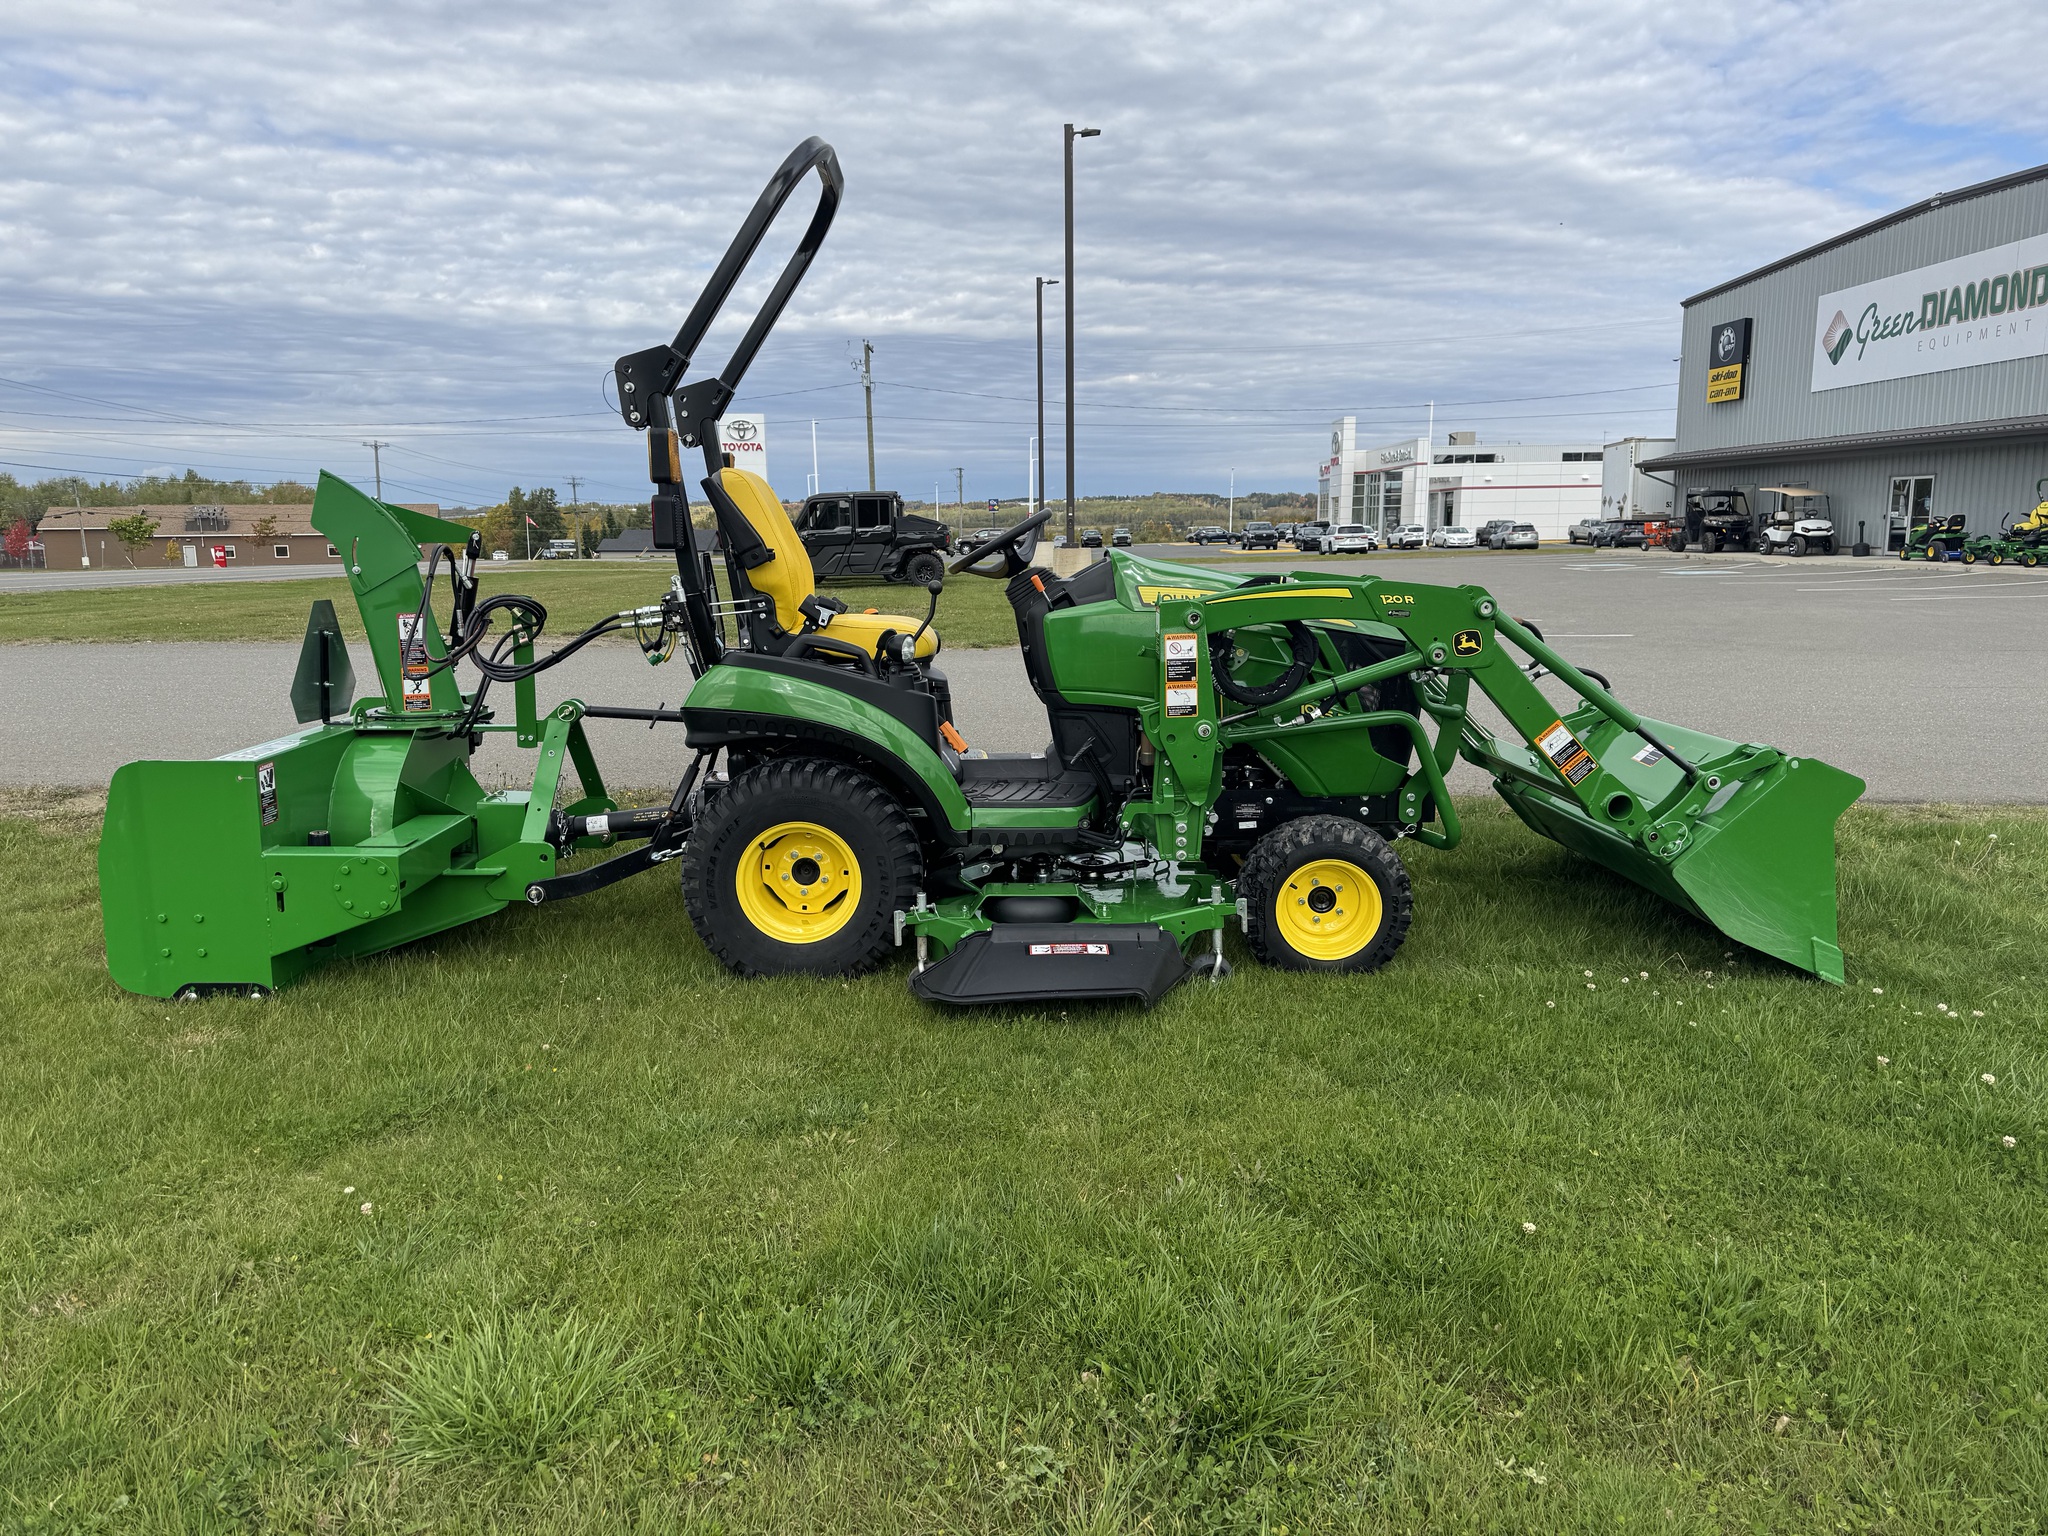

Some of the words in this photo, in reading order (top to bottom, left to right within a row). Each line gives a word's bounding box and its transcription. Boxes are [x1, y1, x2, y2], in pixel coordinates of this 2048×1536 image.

[1856, 302, 1922, 361] Green
[1919, 263, 2048, 332] DIAMOND
[1917, 318, 2032, 352] EQUIPMENT
[1710, 369, 1738, 383] ski-doo
[1709, 386, 1738, 399] can-am
[722, 442, 763, 452] TOYOTA
[1380, 594, 1403, 605] 120
[1404, 595, 1415, 604] R
[706, 855, 718, 910] VERSA
[713, 815, 741, 852] TURF
